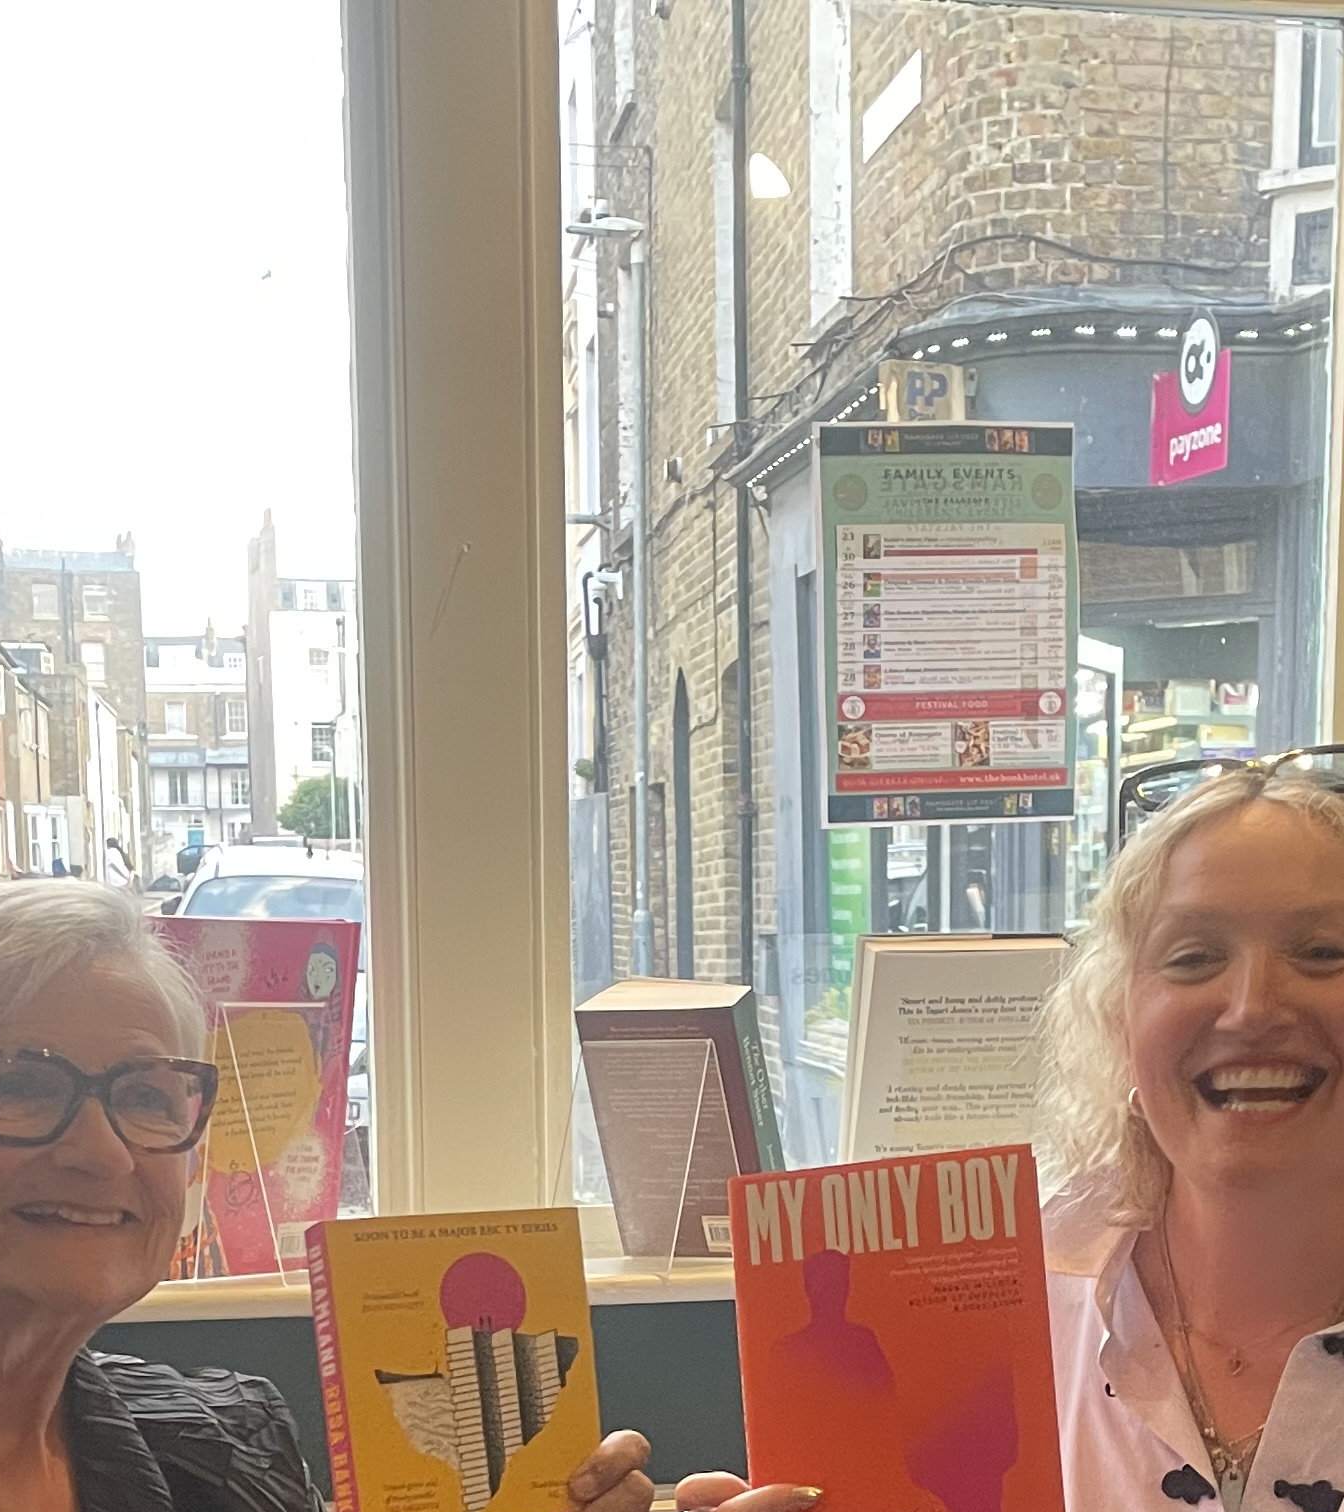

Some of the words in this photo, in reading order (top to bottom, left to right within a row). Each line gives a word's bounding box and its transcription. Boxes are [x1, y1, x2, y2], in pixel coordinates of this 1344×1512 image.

[1169, 422, 1223, 466] payzone
[884, 468, 943, 480] FAMILY
[953, 468, 1015, 480] EVENTS
[842, 532, 854, 541] 23
[842, 553, 856, 561] 30
[842, 581, 855, 590] 26
[842, 611, 855, 621] 27
[916, 700, 959, 710] FESTIVAL
[962, 700, 988, 709] FOOD
[745, 1176, 805, 1265] MY
[821, 1163, 921, 1256] ONLY
[936, 1153, 1021, 1244] BOY
[354, 1230, 390, 1242] SOON
[392, 1229, 409, 1240] TO
[428, 1229, 437, 1239] A
[438, 1226, 477, 1238] MAJOR
[504, 1224, 520, 1234] TV
[309, 1244, 337, 1377] DREAMLAND
[325, 1383, 345, 1447] ROSA
